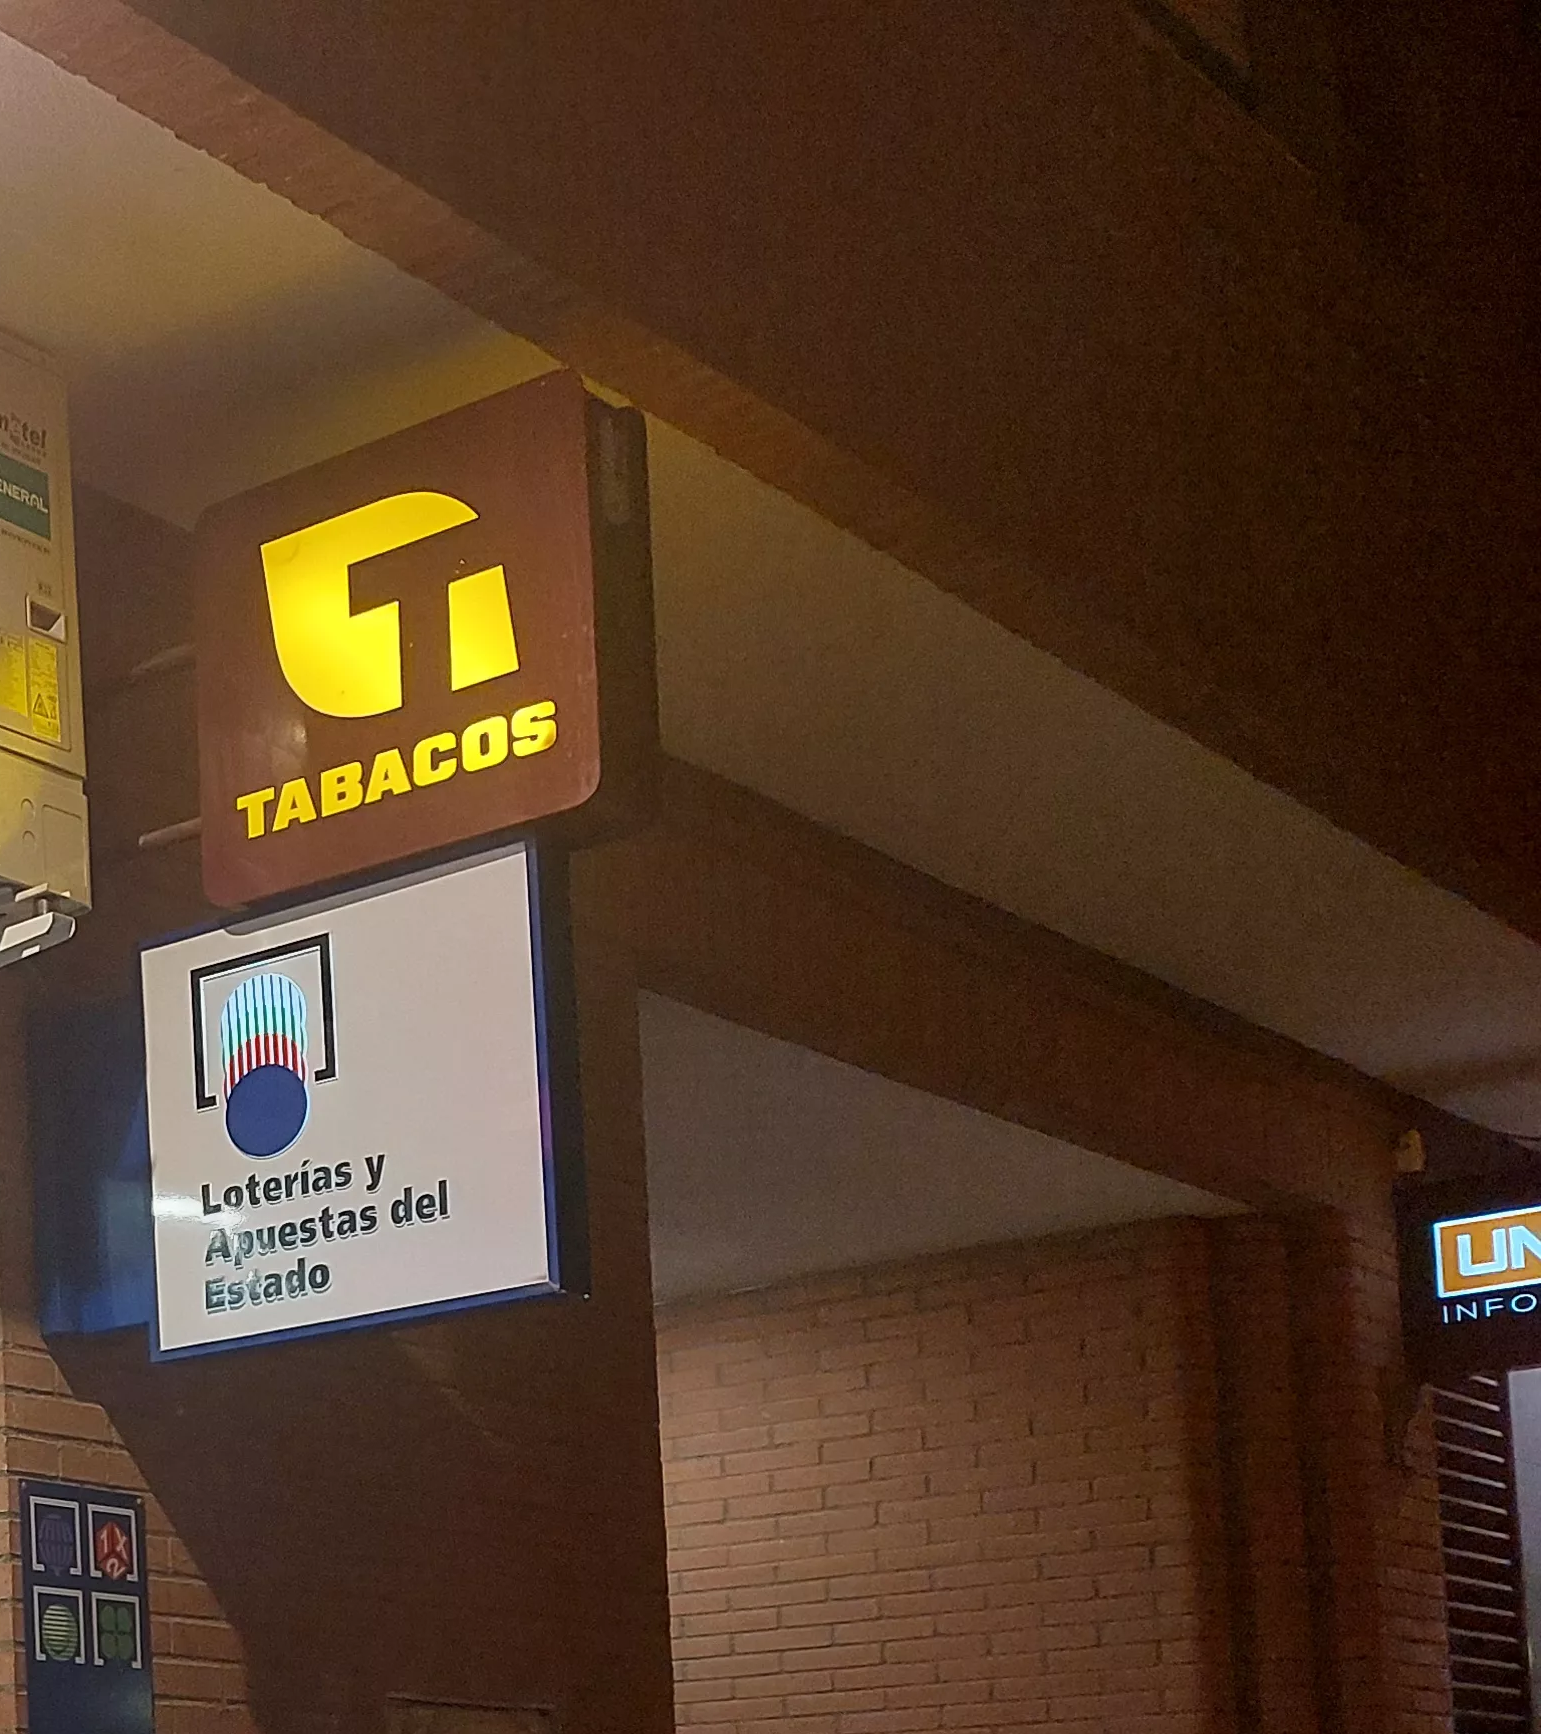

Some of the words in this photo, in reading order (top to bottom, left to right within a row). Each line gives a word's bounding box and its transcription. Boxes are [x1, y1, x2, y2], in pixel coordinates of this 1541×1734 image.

[236, 700, 559, 839] TABACOS
[201, 1160, 353, 1216] Loterías
[364, 1154, 386, 1193] y
[203, 1203, 378, 1268] Apuestas
[391, 1180, 450, 1229] del
[203, 1257, 332, 1314] Estado
